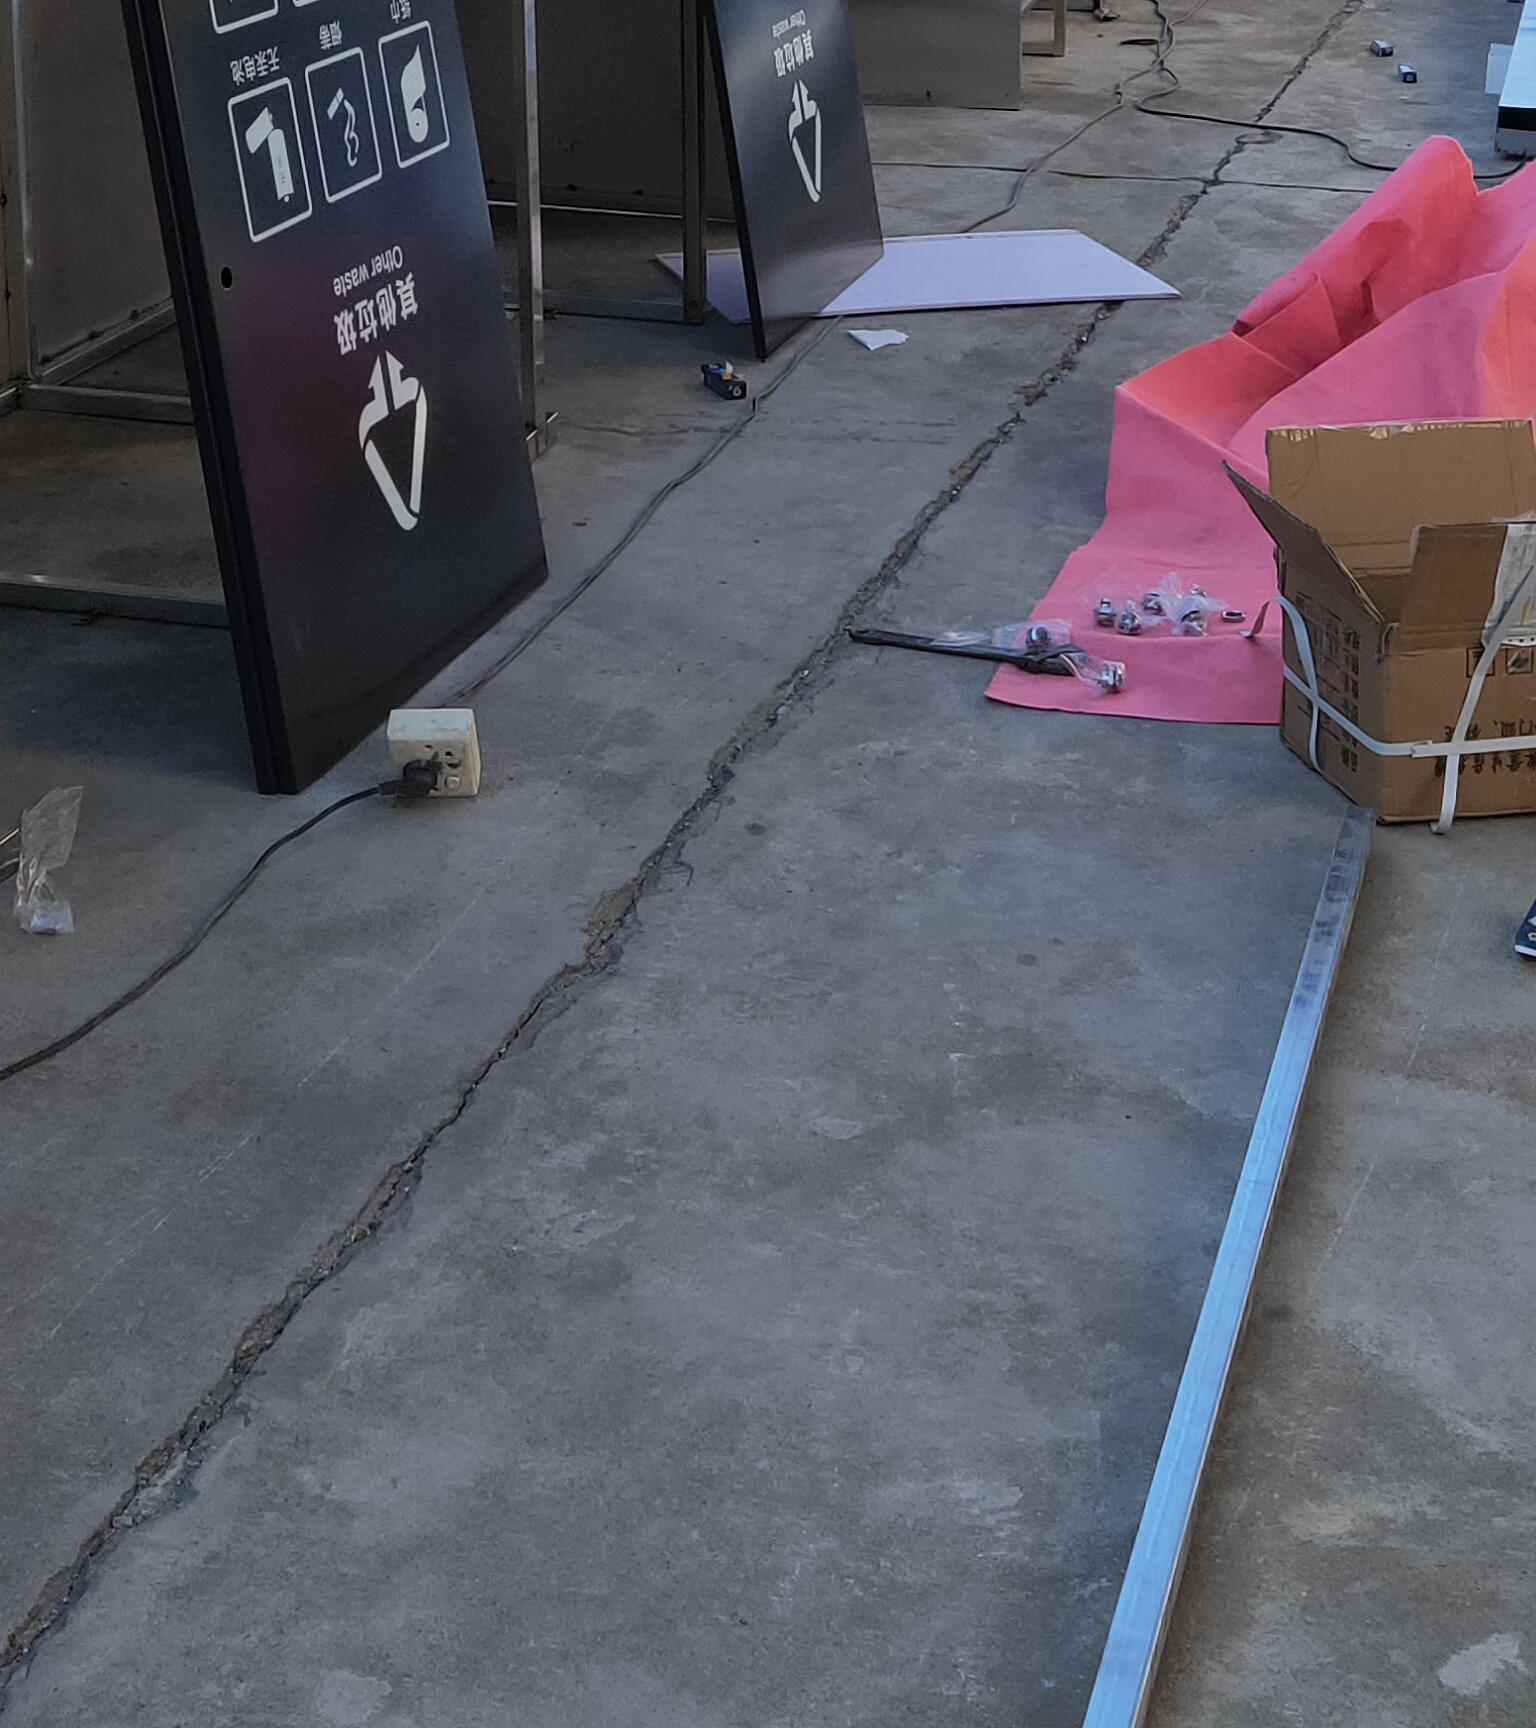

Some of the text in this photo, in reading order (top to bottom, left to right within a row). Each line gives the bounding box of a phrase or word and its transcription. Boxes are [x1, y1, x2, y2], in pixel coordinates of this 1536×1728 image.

[318, 20, 343, 50] 烟蒂
[230, 45, 280, 86] 无汞电池
[332, 246, 404, 297] Other waste
[333, 272, 419, 356] 其他垃圾
